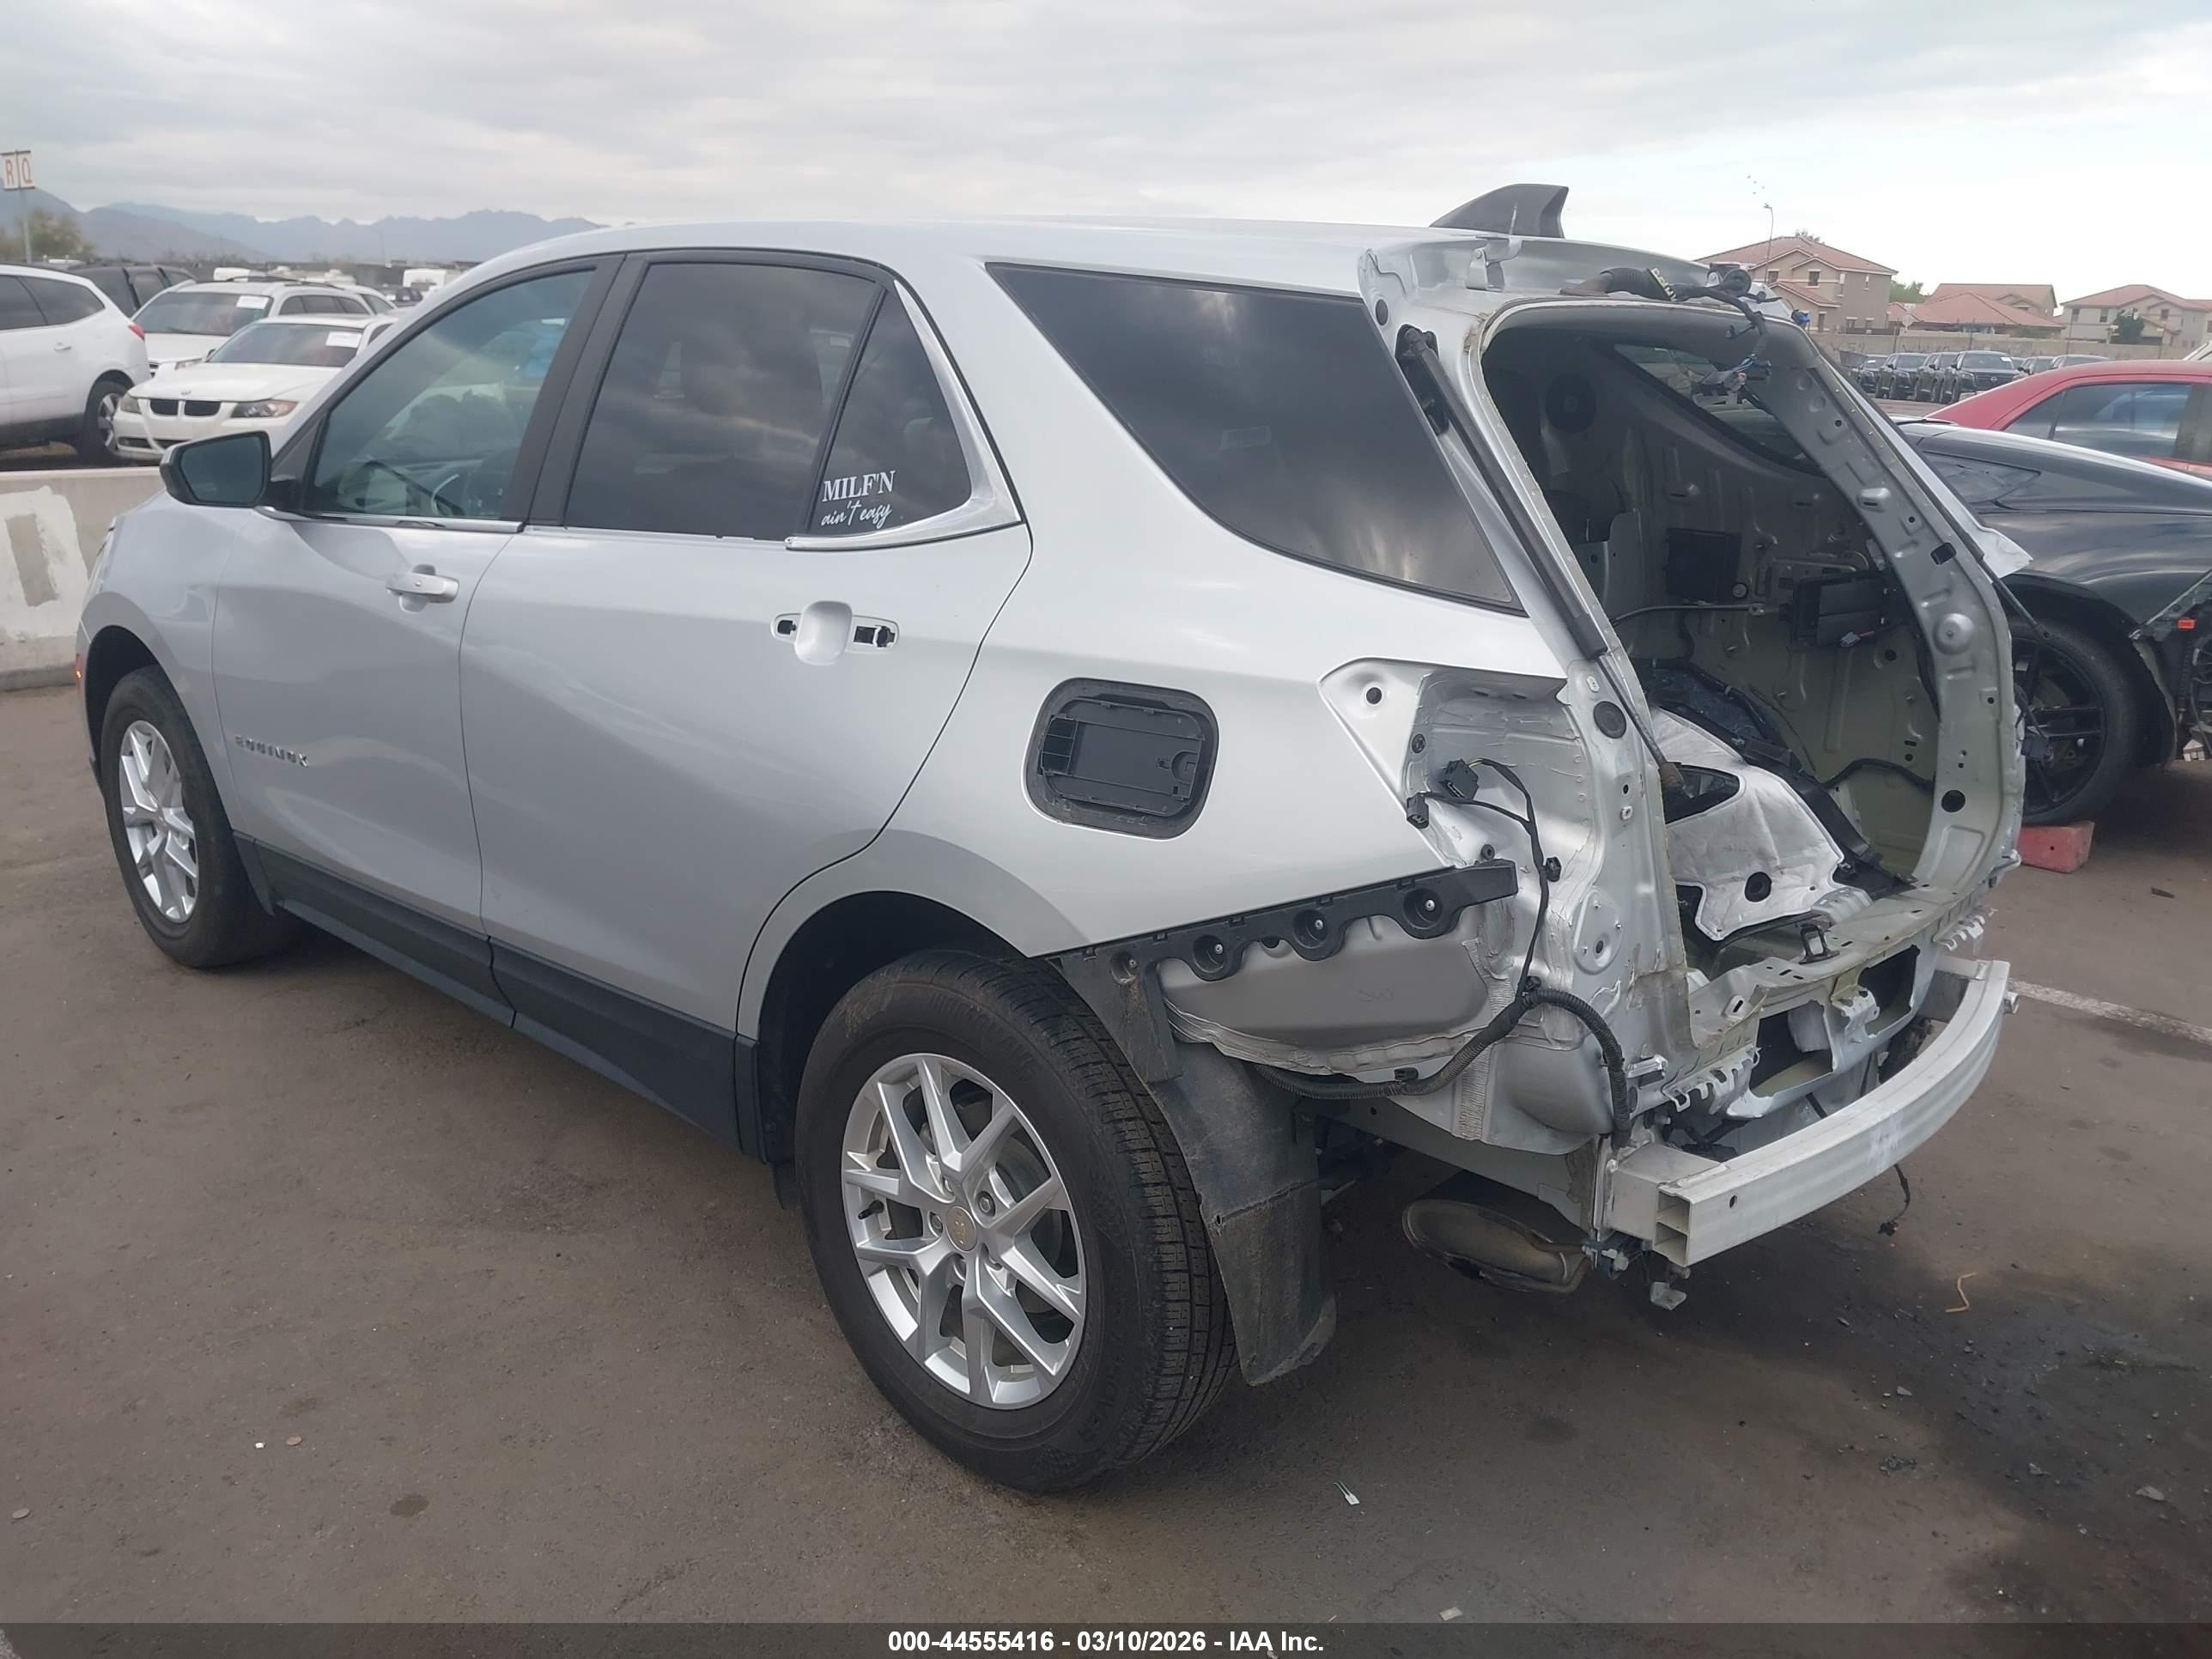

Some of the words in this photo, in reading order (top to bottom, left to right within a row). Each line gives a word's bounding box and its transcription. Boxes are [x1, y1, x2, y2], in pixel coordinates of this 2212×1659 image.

[822, 470, 896, 501] MILF'N
[821, 500, 862, 526] ain't
[860, 503, 893, 529] easy
